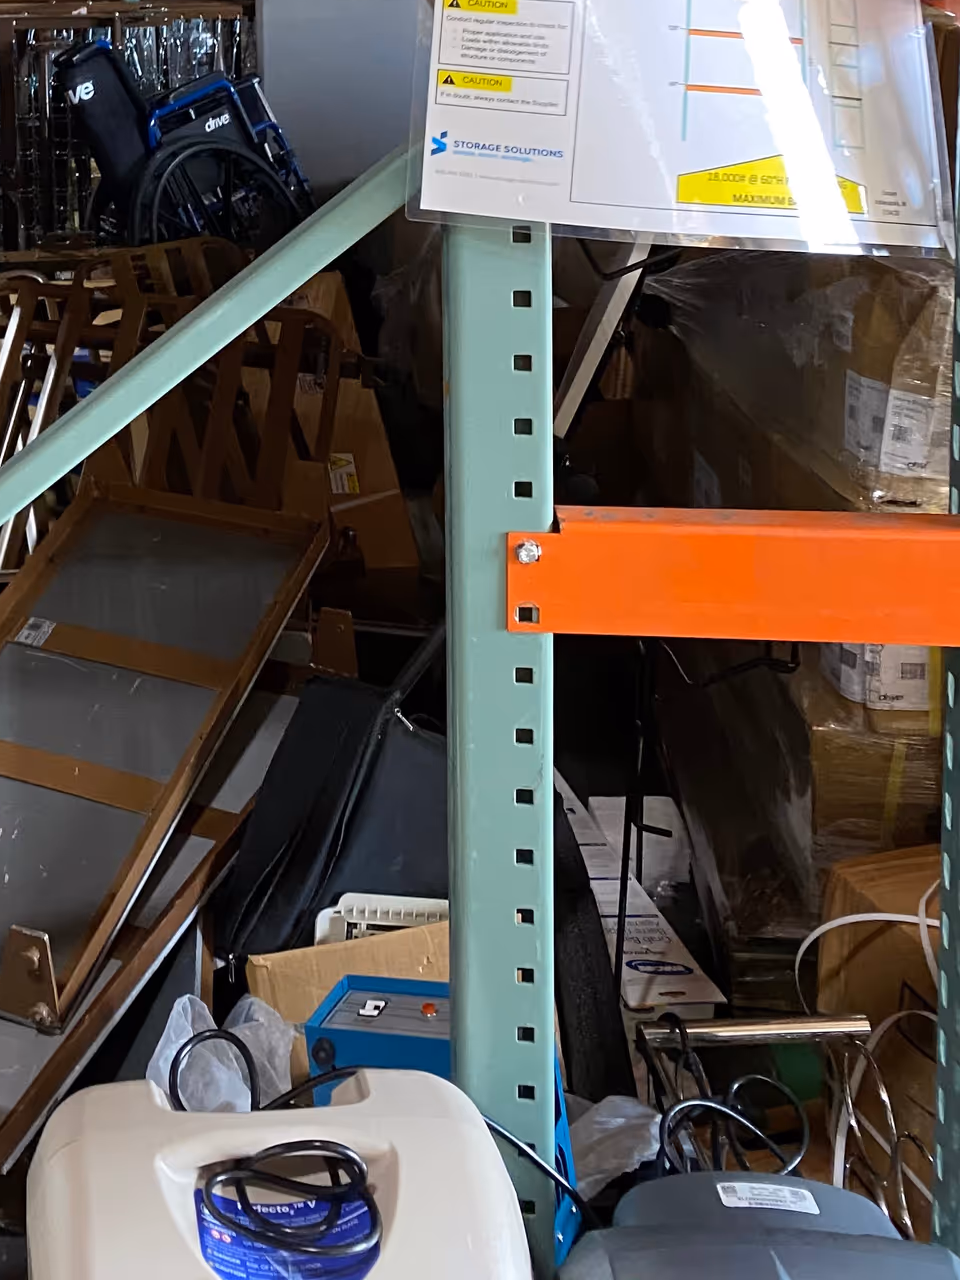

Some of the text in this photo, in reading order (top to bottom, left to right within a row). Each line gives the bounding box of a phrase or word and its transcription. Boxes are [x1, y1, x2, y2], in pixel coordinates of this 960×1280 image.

[467, 0, 509, 9] CAUTION
[462, 76, 503, 87] CAUTION
[204, 112, 230, 133] drive
[453, 140, 502, 152] STORAGE
[503, 145, 564, 158] SOLUTIONS
[748, 174, 758, 185] @
[733, 194, 786, 205] MAXIMUM
